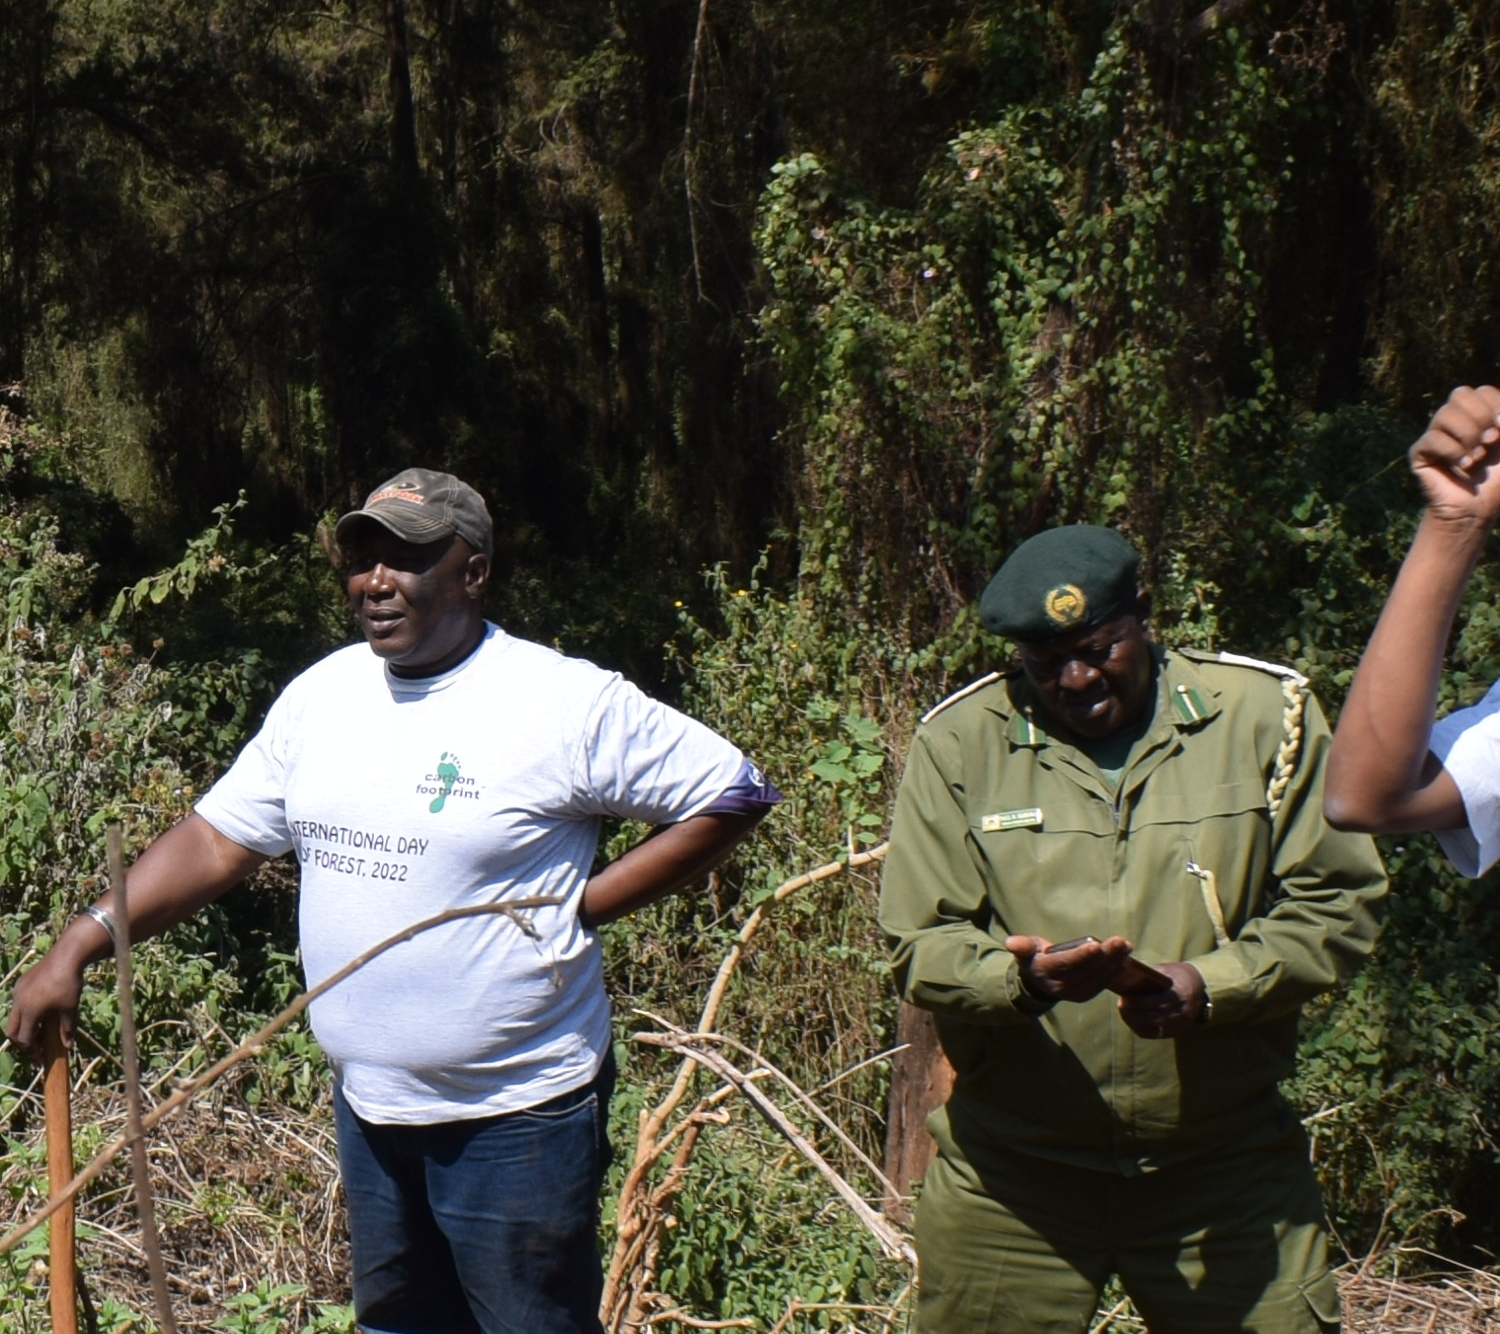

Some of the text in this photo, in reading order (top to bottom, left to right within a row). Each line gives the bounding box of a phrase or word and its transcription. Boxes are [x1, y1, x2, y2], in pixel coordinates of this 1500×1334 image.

[291, 820, 429, 856] NTERNATIONAL DAY
[371, 861, 408, 881] 2022
